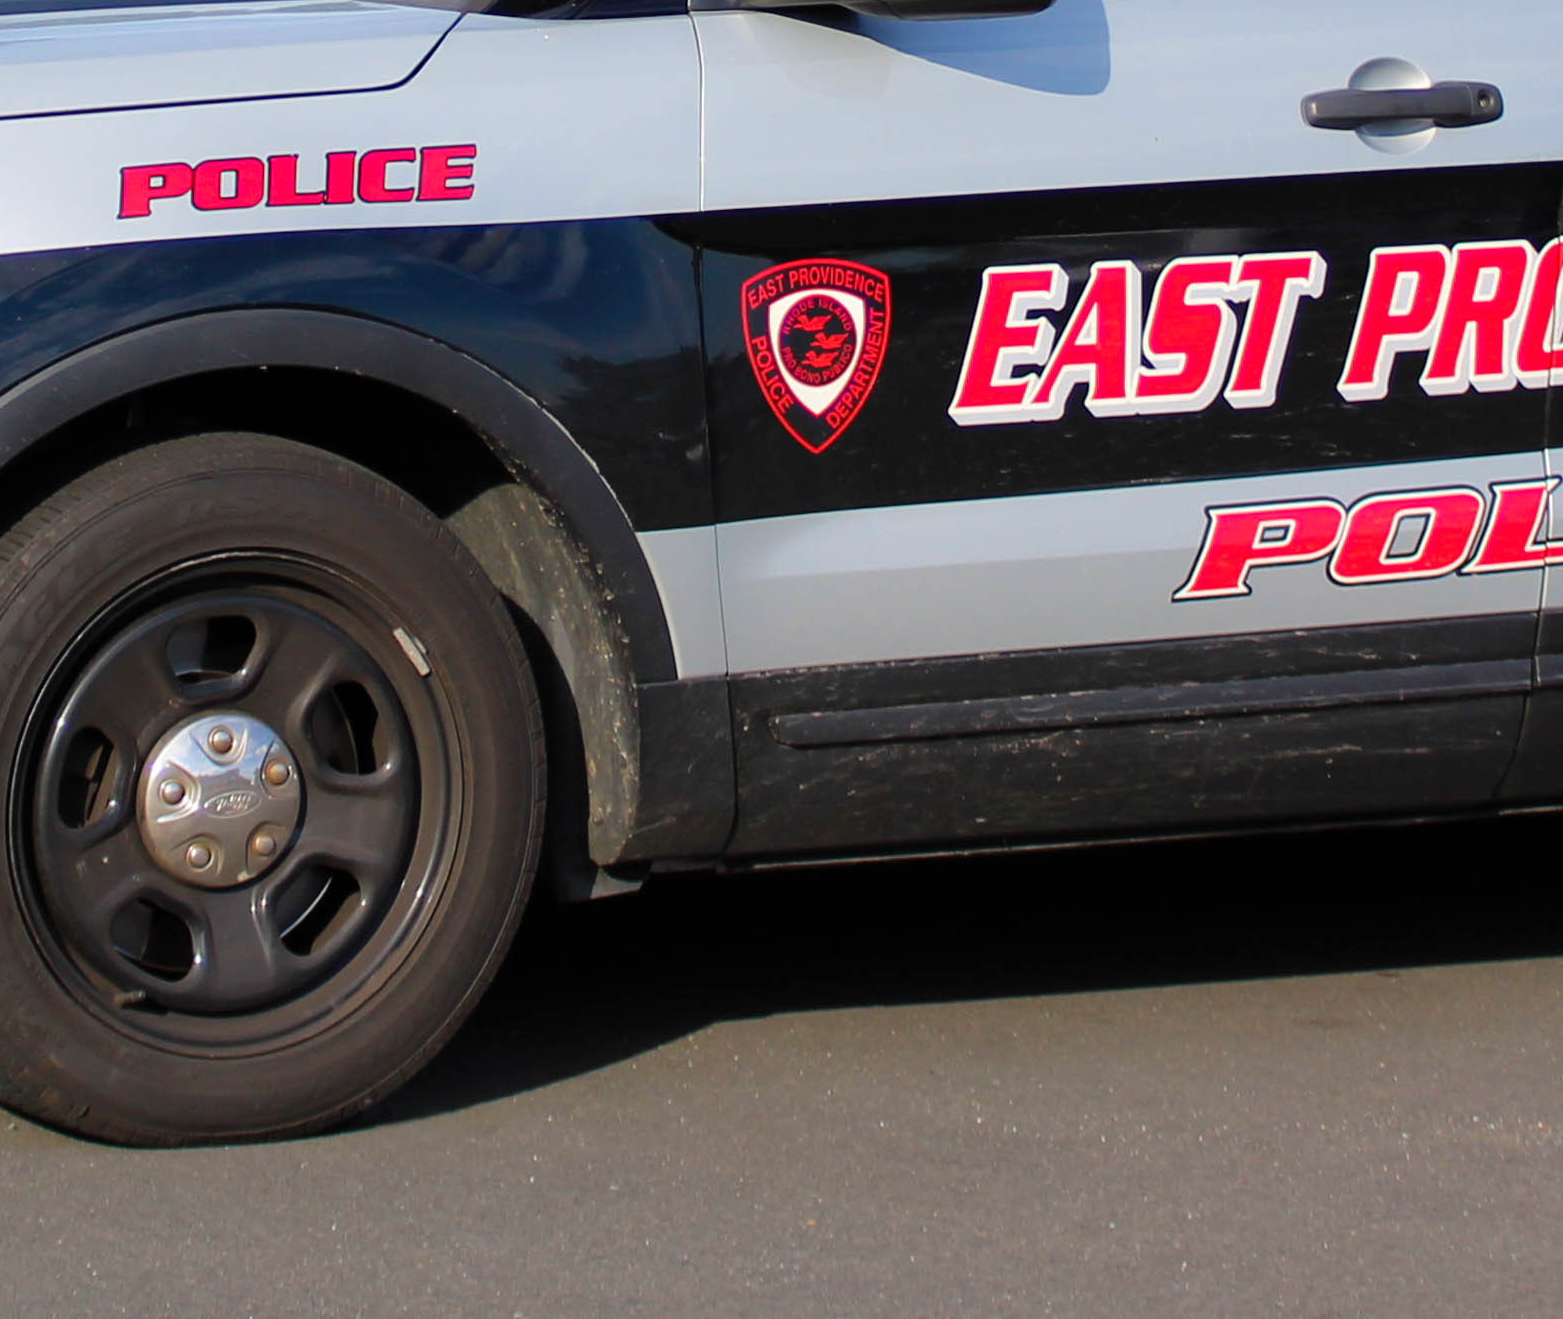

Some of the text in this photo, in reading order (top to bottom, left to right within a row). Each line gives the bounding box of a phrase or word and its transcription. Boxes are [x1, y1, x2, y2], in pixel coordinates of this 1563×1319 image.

[117, 144, 478, 219] POLICE
[748, 267, 884, 309] EAST PROVIDENCE
[783, 298, 852, 334] RHODE ISLAND
[751, 335, 794, 413] POLICE
[825, 307, 884, 429] DEPARTMENT
[948, 251, 1326, 428] EAST
